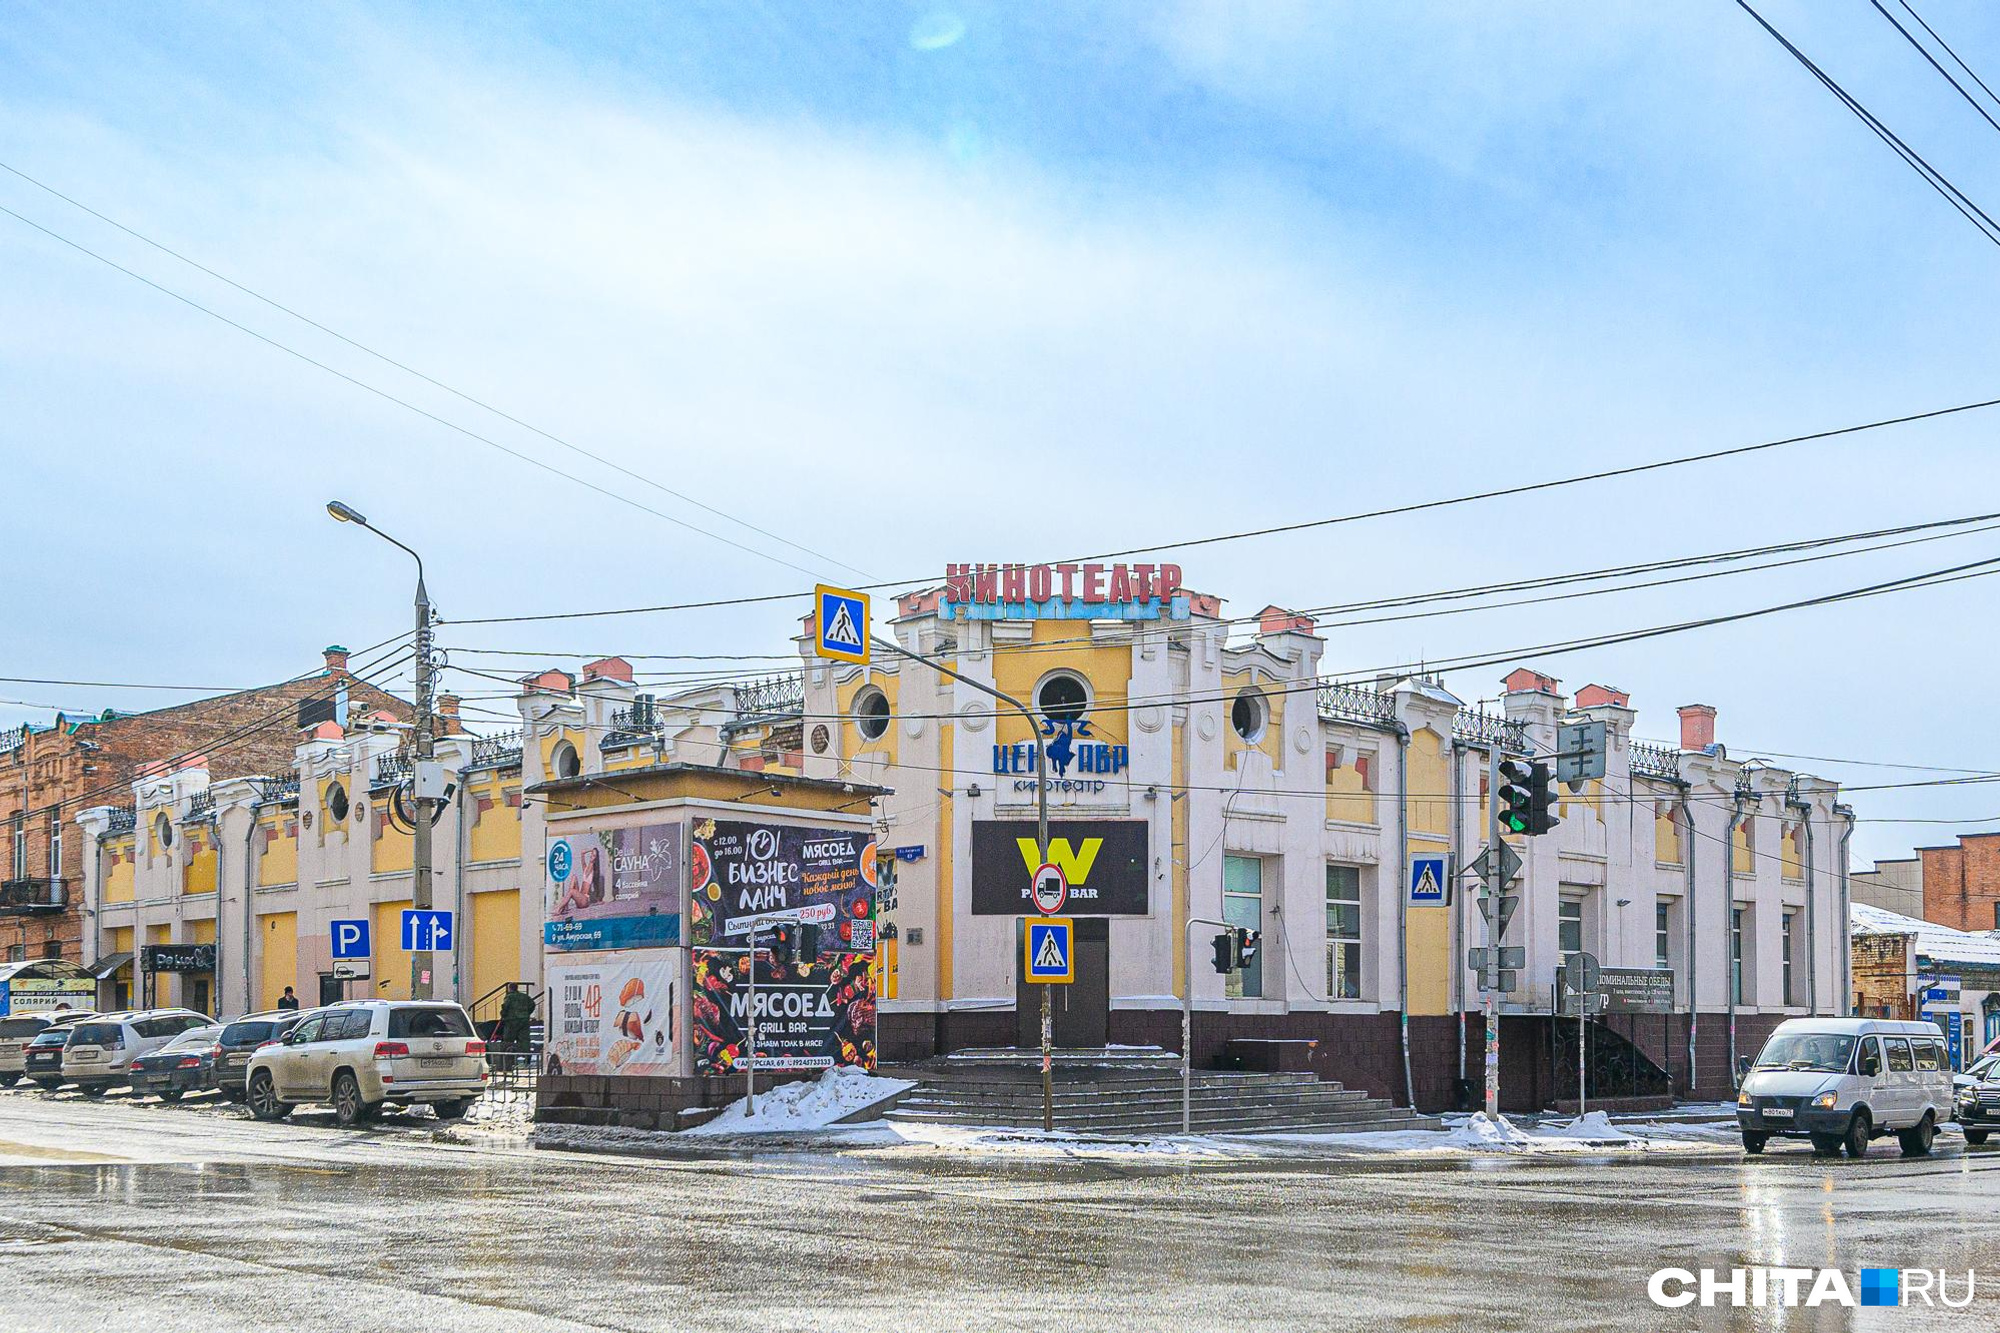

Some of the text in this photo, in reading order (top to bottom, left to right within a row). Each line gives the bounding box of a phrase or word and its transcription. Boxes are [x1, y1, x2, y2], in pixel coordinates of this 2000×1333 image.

[946, 563, 1182, 604] КИНОТЕАТР
[1013, 780, 1105, 794] кинотеатр
[719, 836, 737, 845] 12.00
[554, 852, 564, 864] 24
[724, 846, 743, 856] 16.00
[802, 842, 856, 859] МЯСОЕД
[613, 855, 649, 872] САУНА
[832, 858, 843, 866] BAR
[1016, 838, 1104, 885] W
[728, 861, 798, 885] БИЗНЕС
[802, 868, 840, 885] Каждый
[840, 868, 859, 882] день
[615, 878, 622, 889] 4
[803, 877, 856, 896] новое меню!
[739, 885, 787, 911] ЛАНЧ
[877, 887, 894, 901] RTY
[1069, 888, 1099, 899] BAR
[884, 897, 898, 913] BA
[800, 907, 816, 919] 250
[816, 905, 834, 923] руб.
[1648, 976, 1671, 988] ОБЕДЫ
[13, 997, 58, 1005] СОЛЯРИЙ
[729, 992, 835, 1018] МЯСОЕД
[759, 1022, 808, 1033] GRILL BAR
